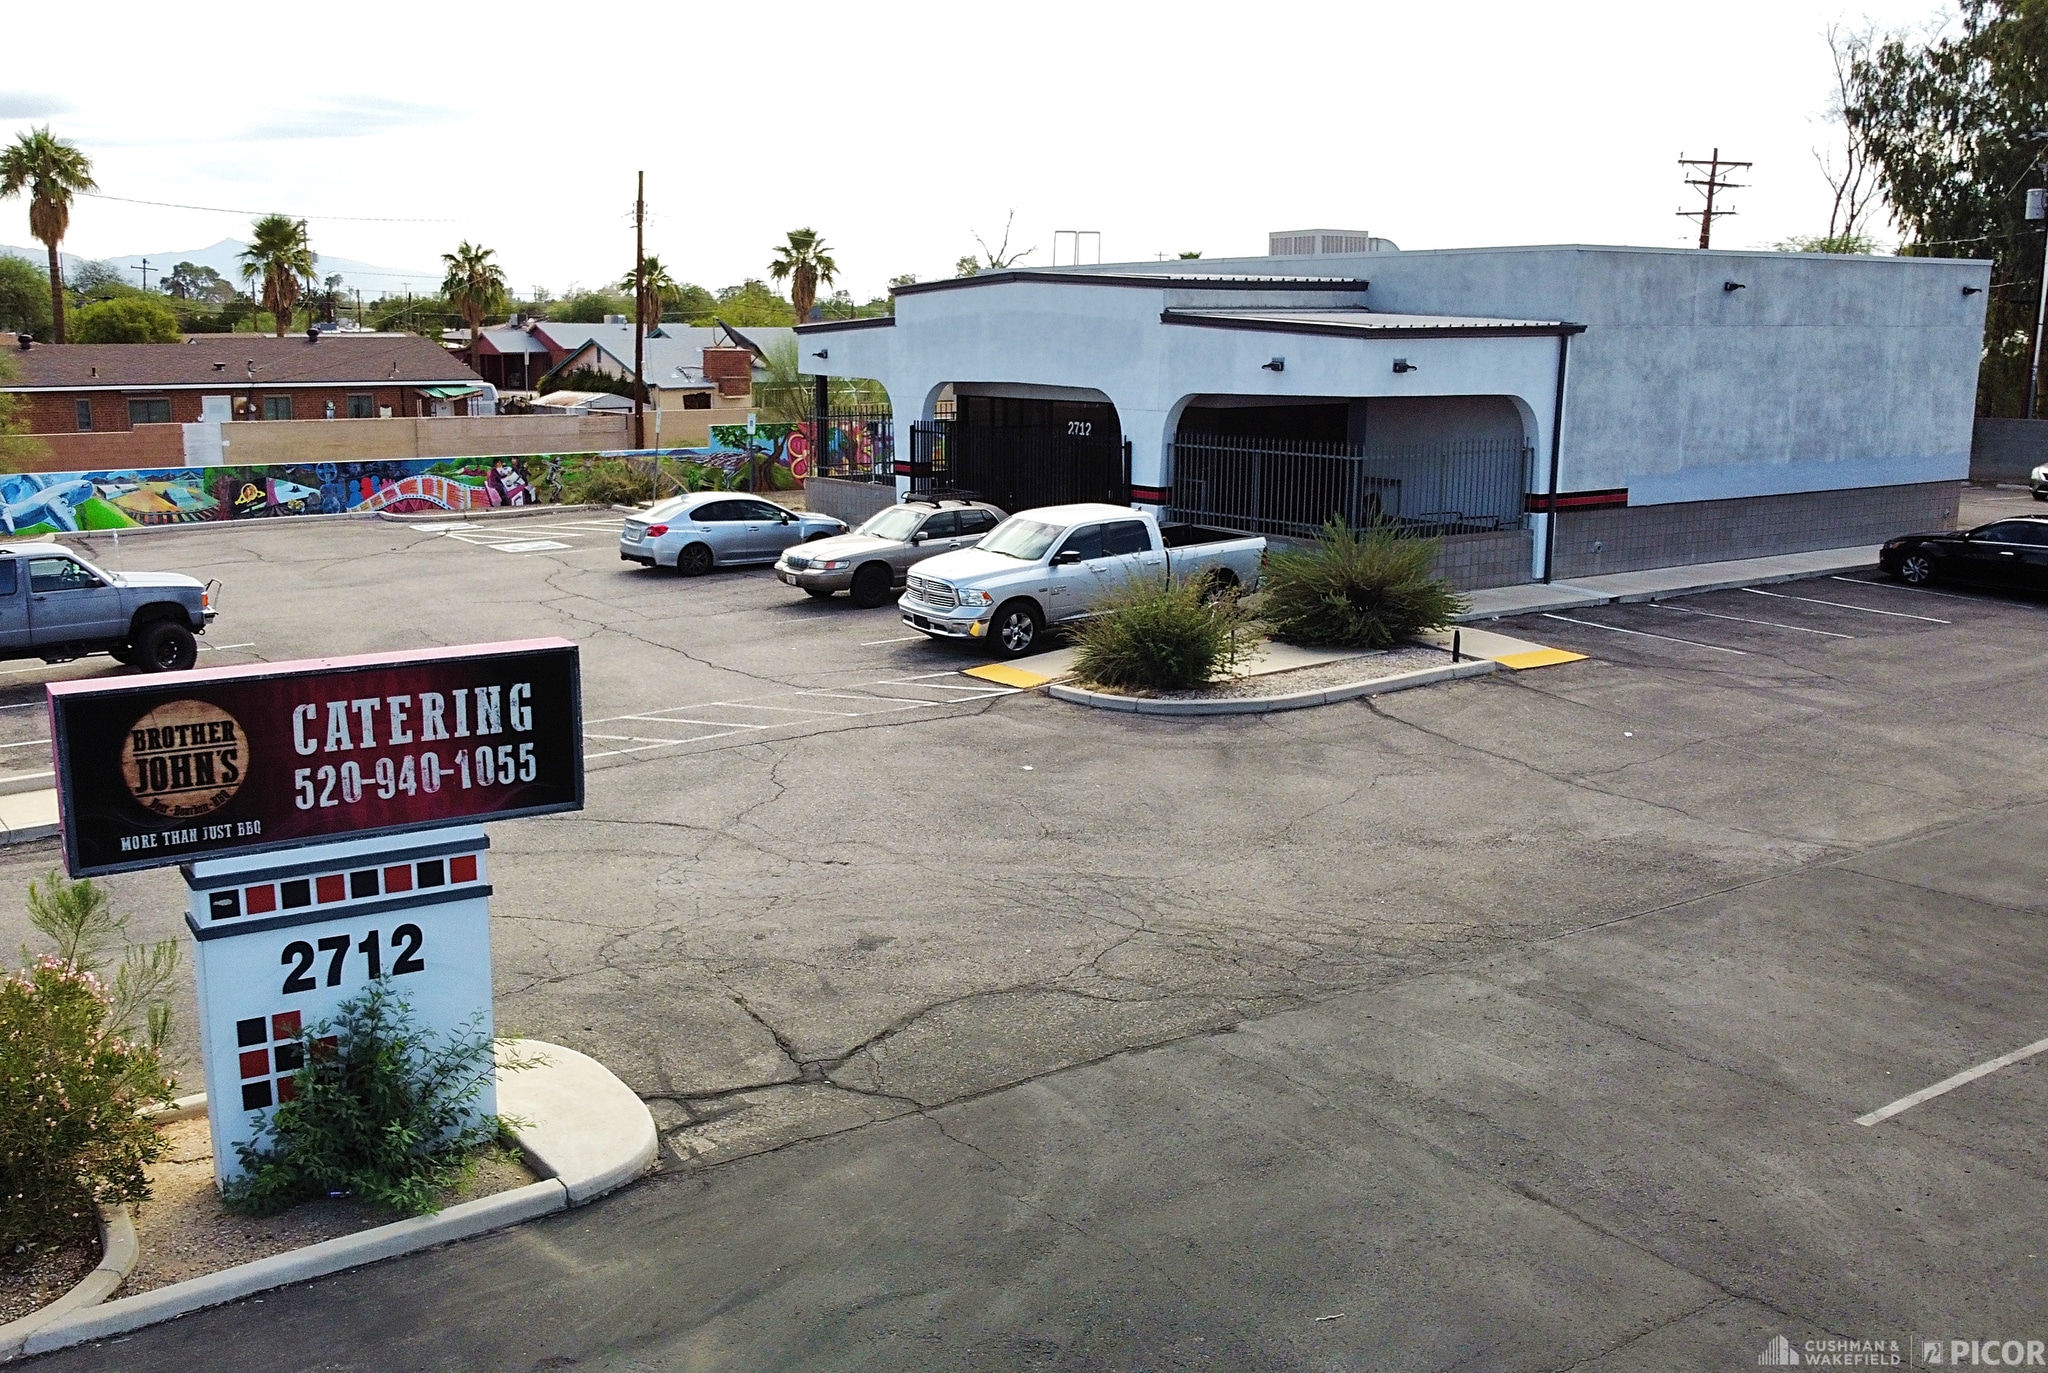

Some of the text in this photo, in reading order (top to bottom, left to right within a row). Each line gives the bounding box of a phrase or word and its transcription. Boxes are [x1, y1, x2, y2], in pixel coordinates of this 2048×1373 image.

[1067, 421, 1092, 436] 2712
[131, 720, 236, 752] BROTHER
[292, 682, 533, 755] CATERING
[135, 747, 239, 793] JOHN'S
[294, 743, 537, 810] 520-940-1055
[120, 820, 262, 851] MORE THAN JUST BBQ
[281, 923, 425, 995] 2712
